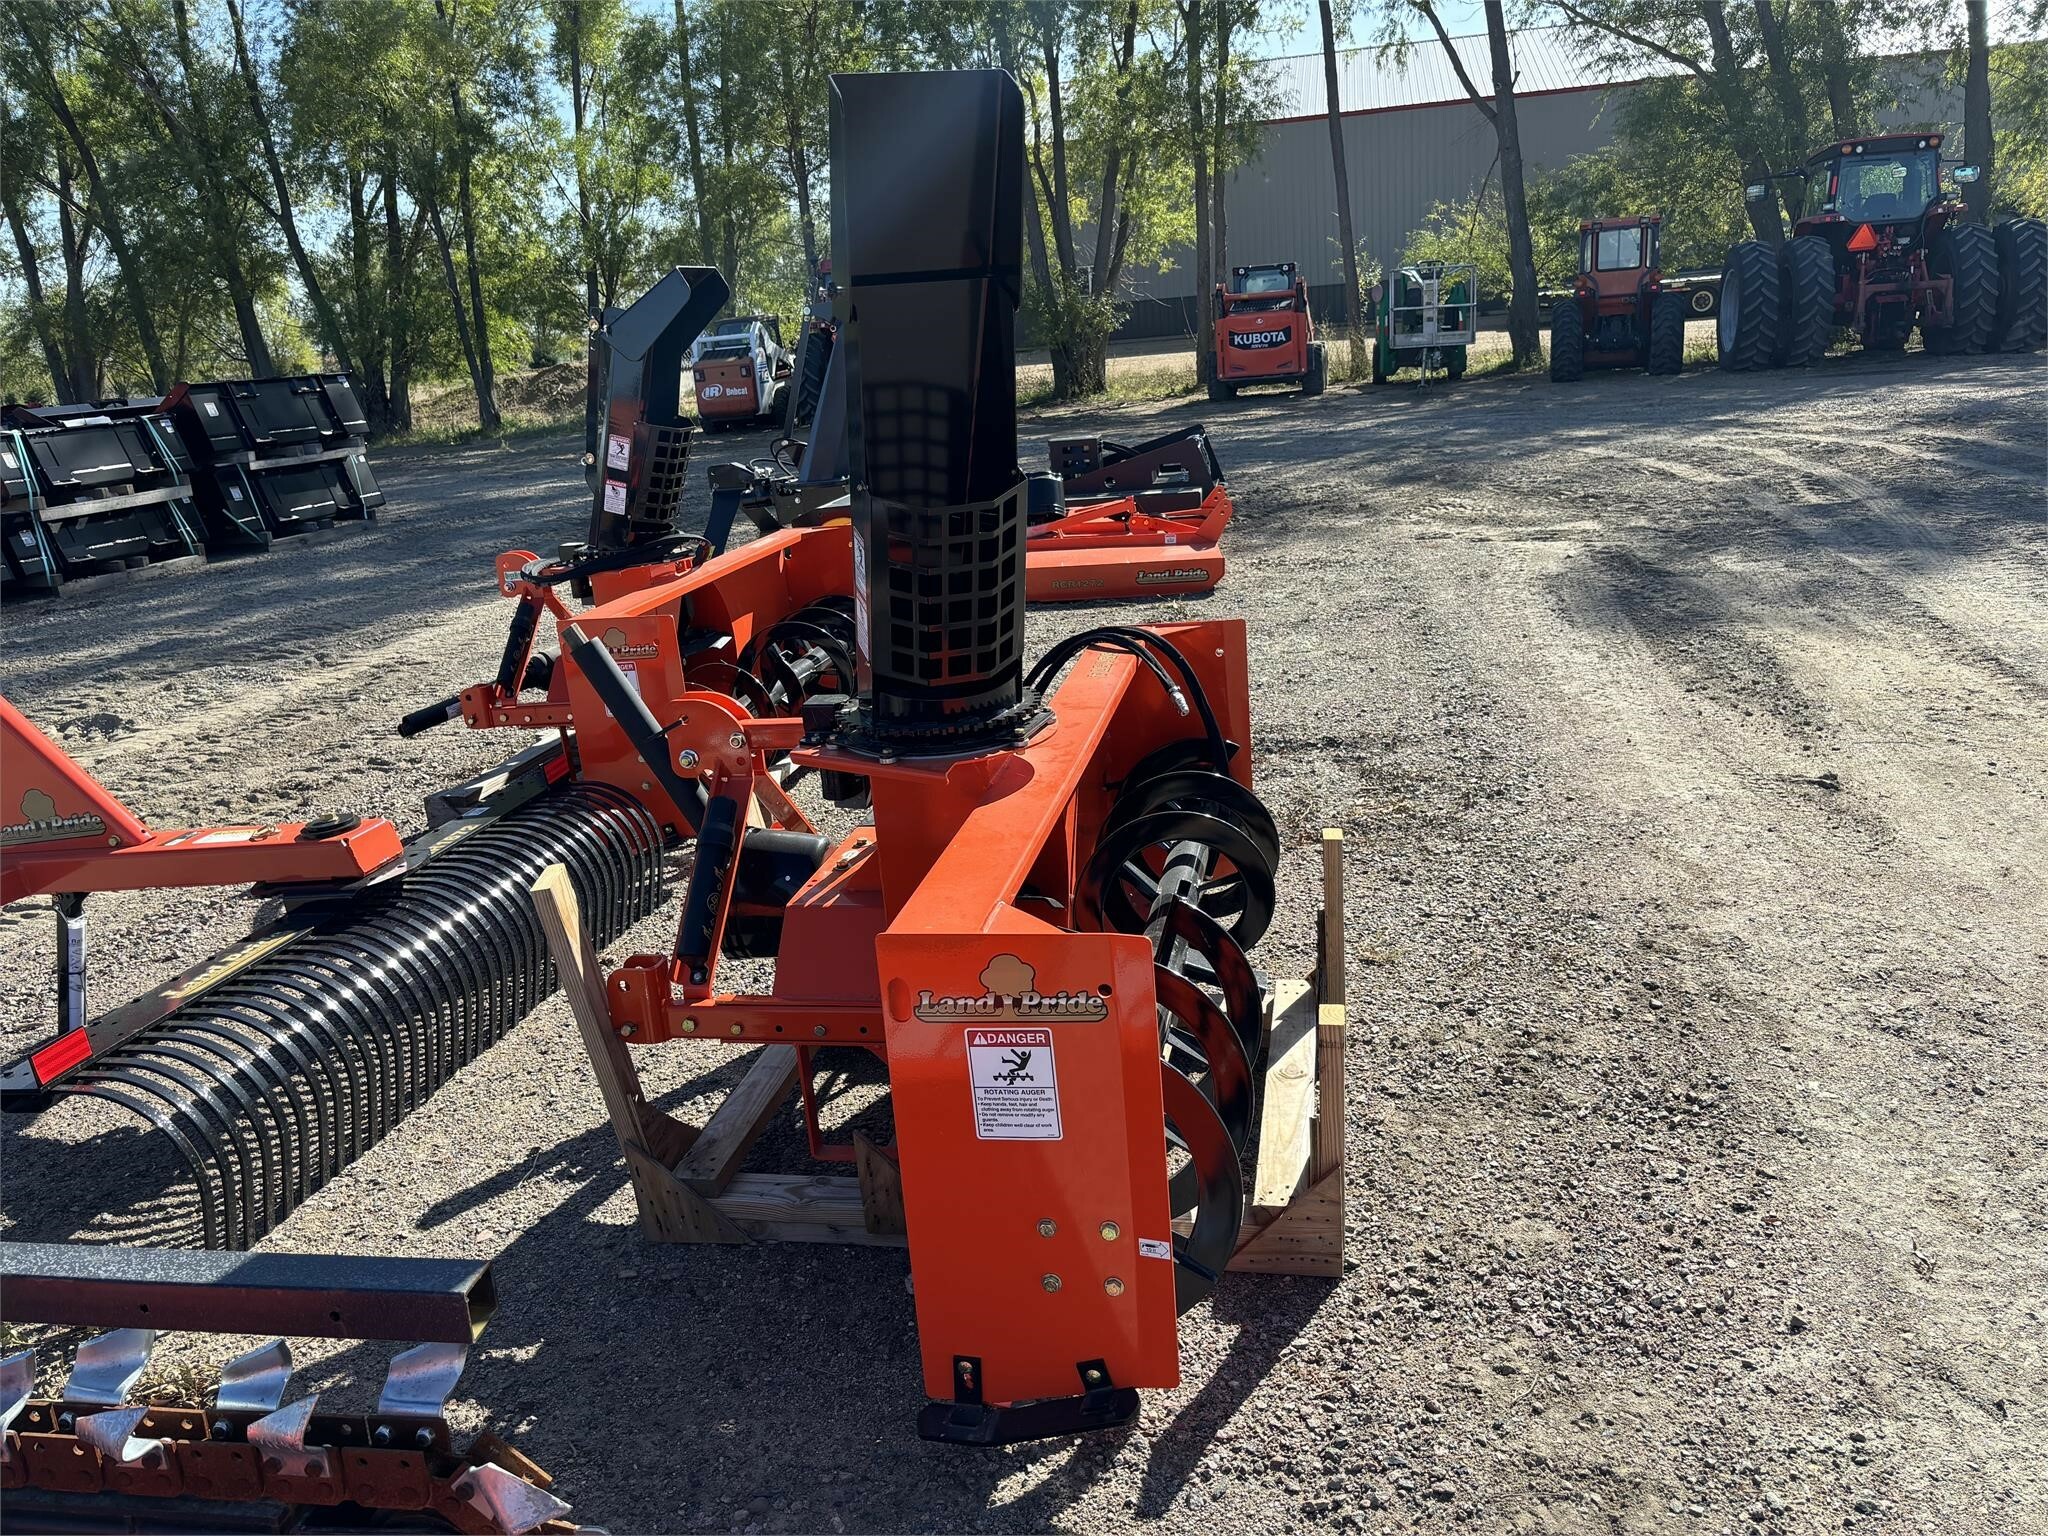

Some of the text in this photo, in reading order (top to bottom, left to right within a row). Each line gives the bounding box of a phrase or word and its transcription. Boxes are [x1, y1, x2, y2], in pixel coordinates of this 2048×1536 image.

[1234, 331, 1286, 345] KUBOTA
[725, 387, 748, 396] Bobcat
[621, 645, 656, 656] Pride
[0, 811, 105, 839] and Pride
[918, 991, 1104, 1014] Land Pride
[987, 1033, 1046, 1044] DANGER
